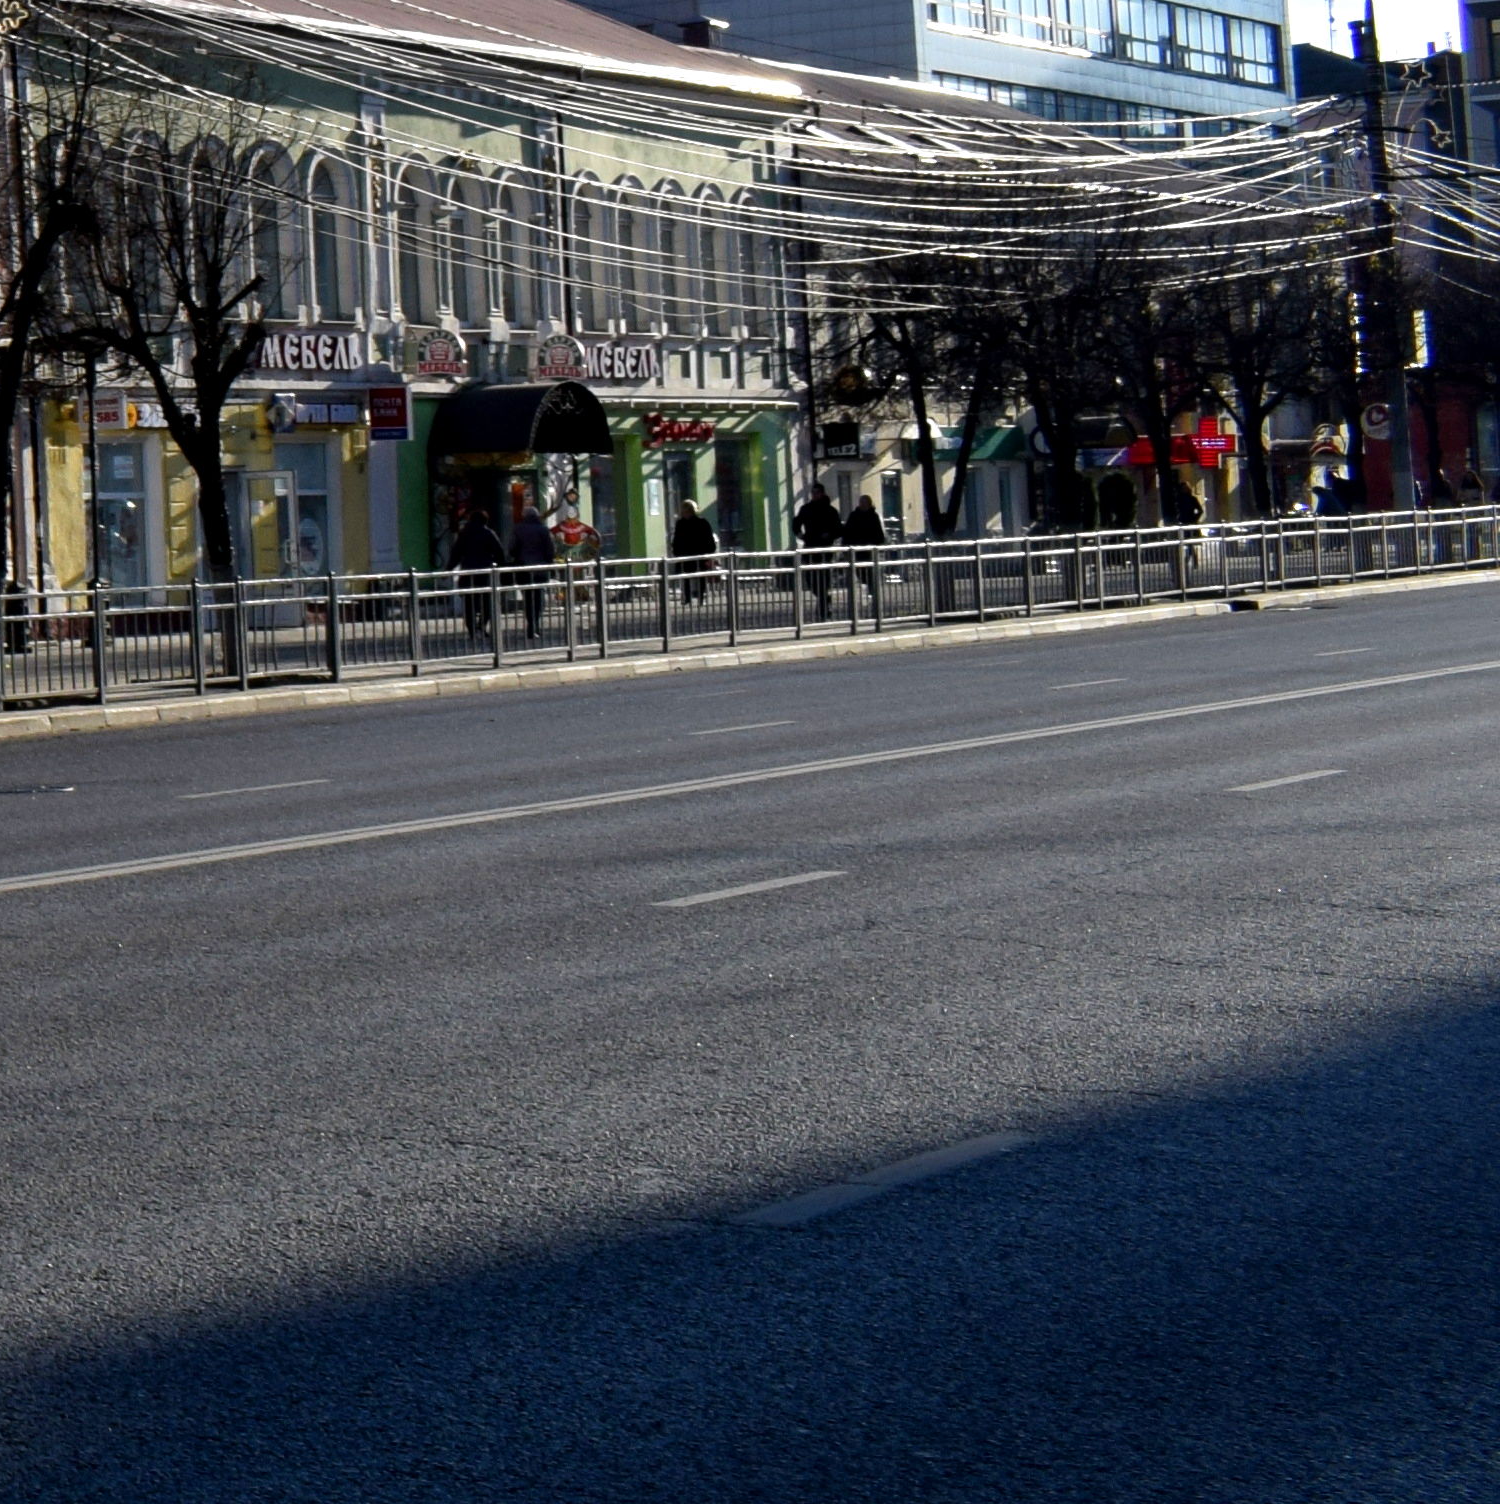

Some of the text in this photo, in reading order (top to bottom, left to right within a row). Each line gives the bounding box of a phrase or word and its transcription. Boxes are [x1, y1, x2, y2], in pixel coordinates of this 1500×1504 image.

[260, 333, 364, 371] МЕБЕЛЬ
[585, 345, 661, 379] МЕБЕЛЬ
[96, 411, 120, 424] 585
[827, 443, 858, 456] TELE2
